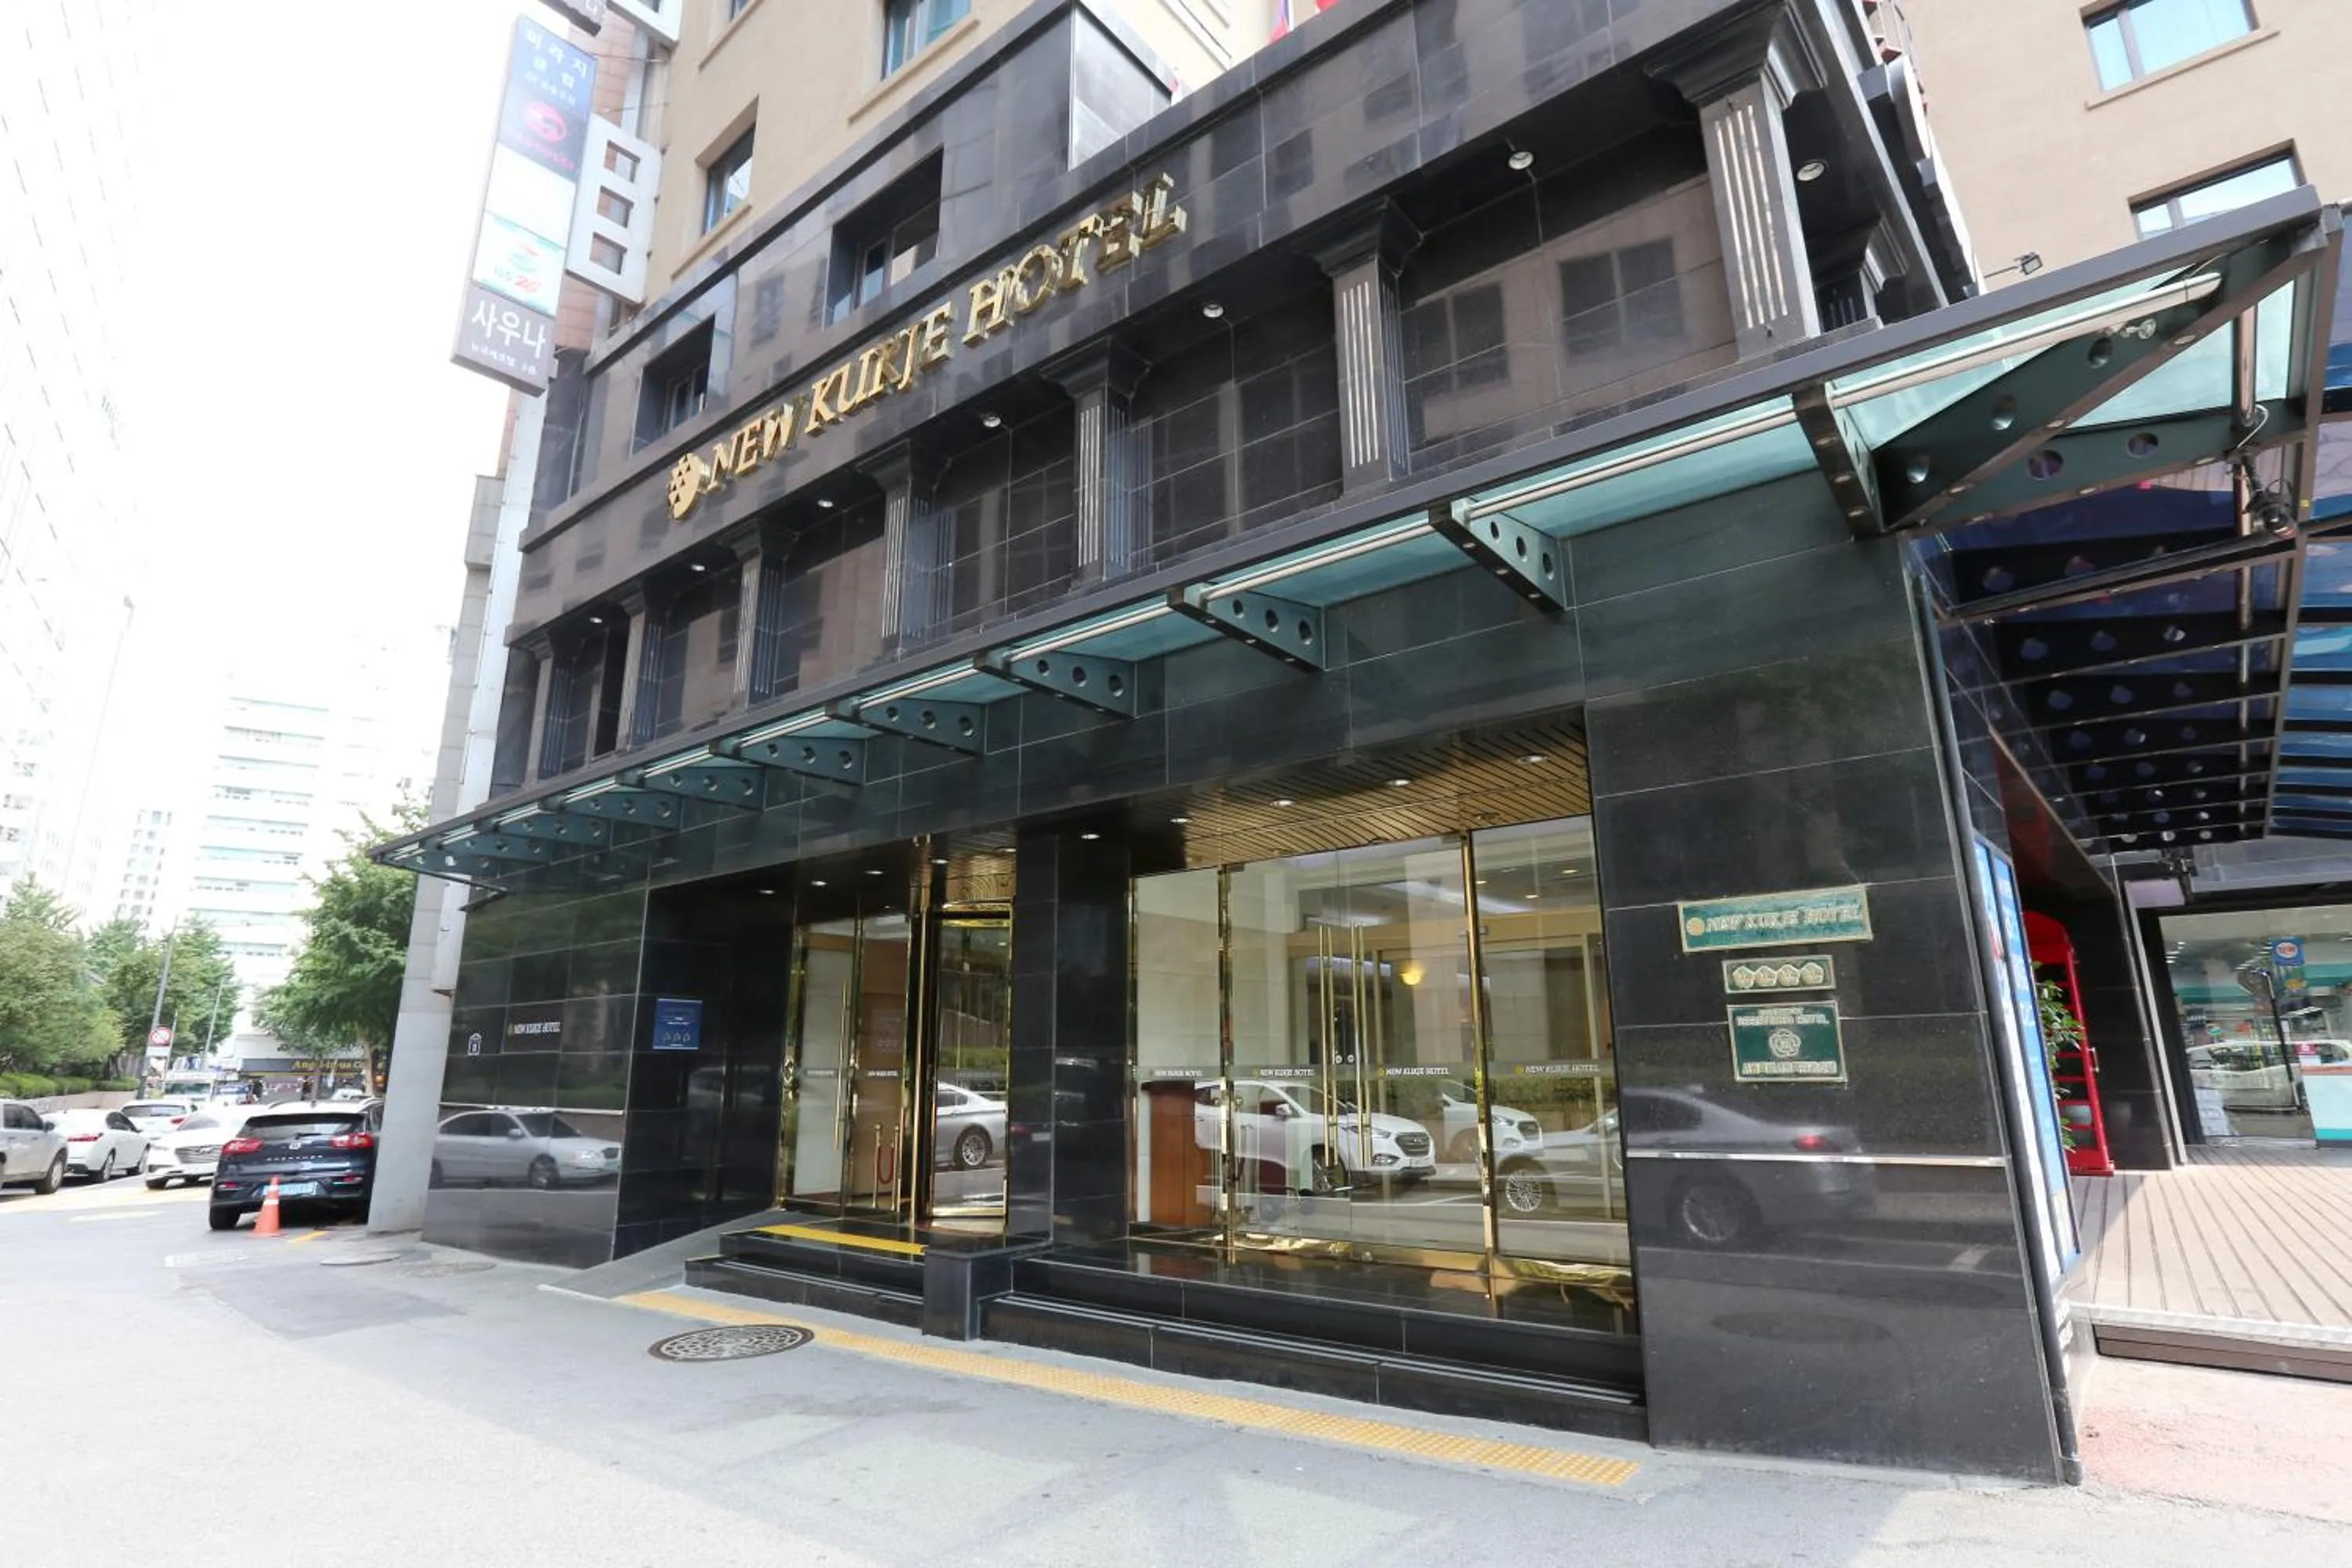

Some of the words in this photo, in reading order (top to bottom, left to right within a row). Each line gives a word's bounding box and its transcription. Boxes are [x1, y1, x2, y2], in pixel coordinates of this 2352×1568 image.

[471, 300, 546, 359] 사우나
[707, 397, 808, 491] NEW
[805, 301, 954, 434] KUKJE
[962, 172, 1187, 345] HOTEL
